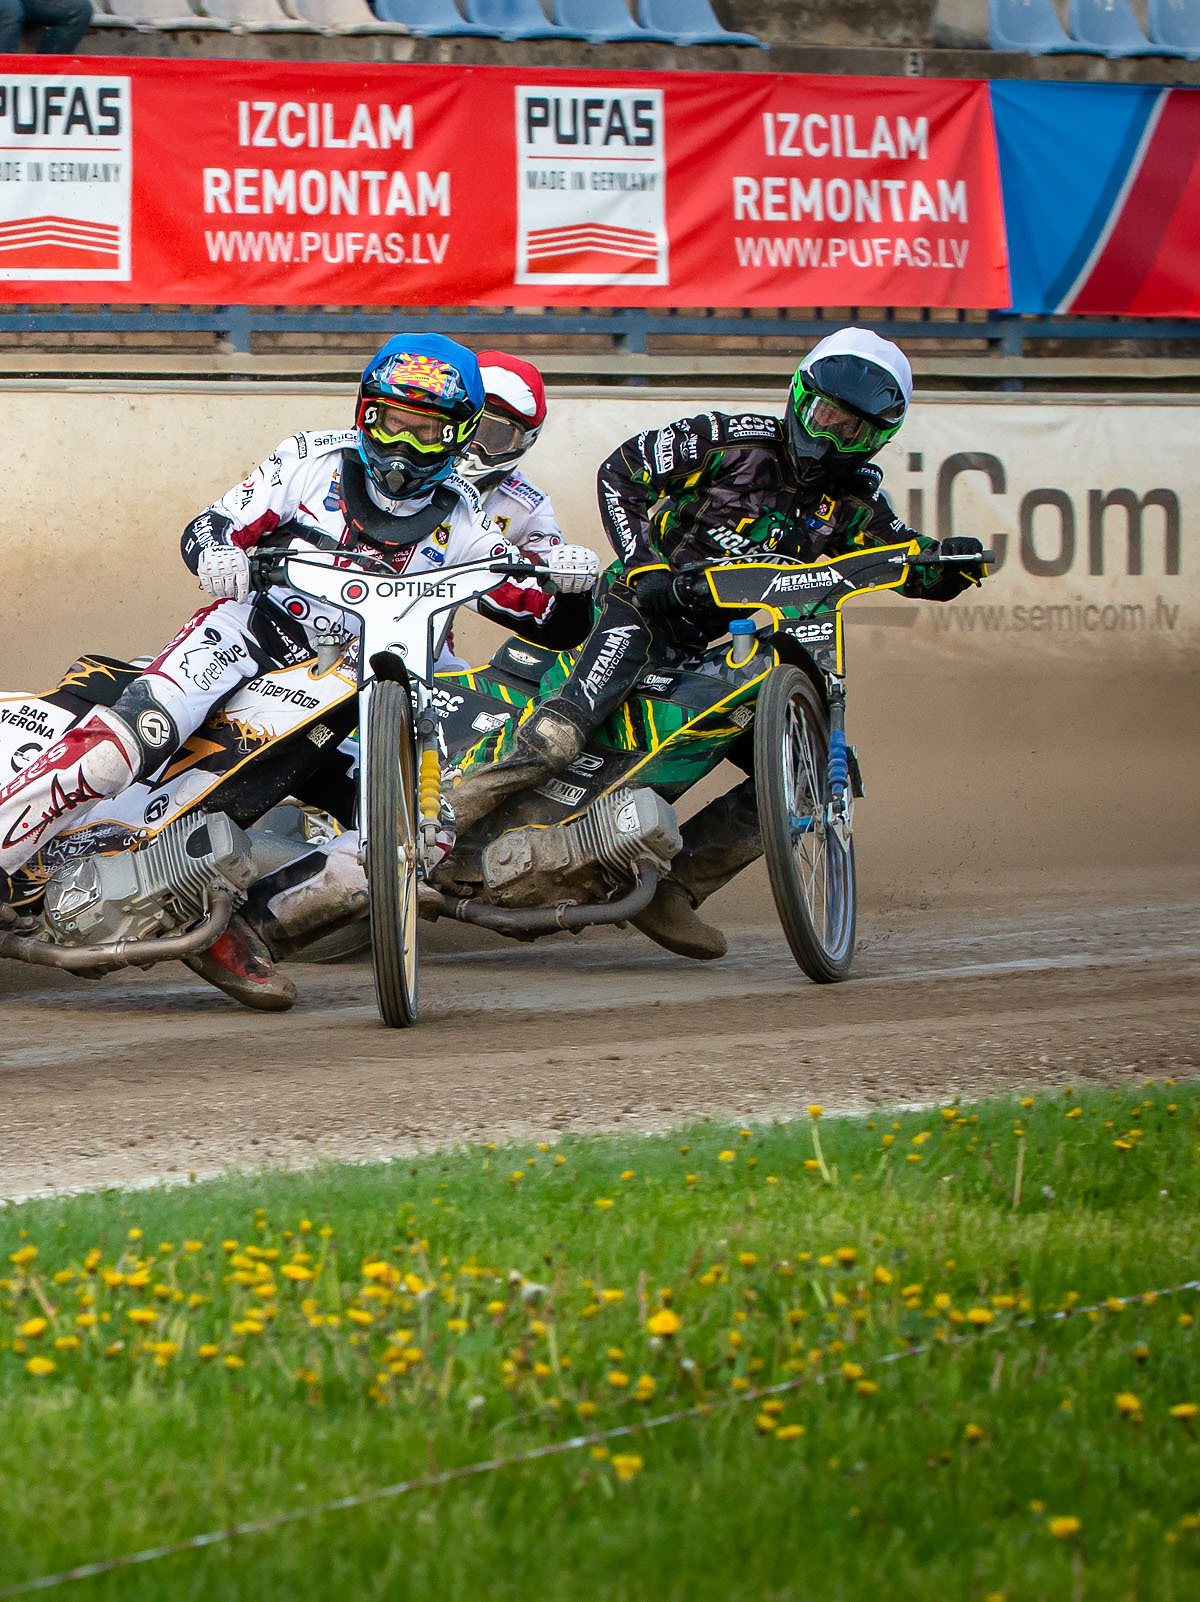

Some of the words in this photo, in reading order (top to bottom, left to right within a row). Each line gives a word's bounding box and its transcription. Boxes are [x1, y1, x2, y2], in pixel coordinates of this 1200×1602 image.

[238, 101, 414, 150] IZCILAM
[526, 98, 655, 146] PUFAS
[763, 112, 929, 160] IZCILAM
[27, 162, 43, 183] IN
[49, 162, 123, 183] GERMANY
[526, 170, 567, 191] MADE
[571, 171, 586, 191] IN
[591, 171, 657, 192] GERMANY
[203, 168, 452, 216] REMONTAM
[733, 177, 968, 223] REMONTAM
[204, 230, 451, 264] WWW.PUFAS.LV
[734, 237, 969, 269] WWW.PUFAS.LV
[728, 416, 776, 432] ACDC
[376, 581, 457, 598] OPTIBET
[760, 566, 857, 602] METALIKA
[780, 580, 833, 593] RECYCLING
[930, 596, 1181, 632] www.semicom.lv
[578, 624, 641, 712] METALIKA
[597, 638, 631, 690] RECYCLING
[18, 705, 49, 722] BAR
